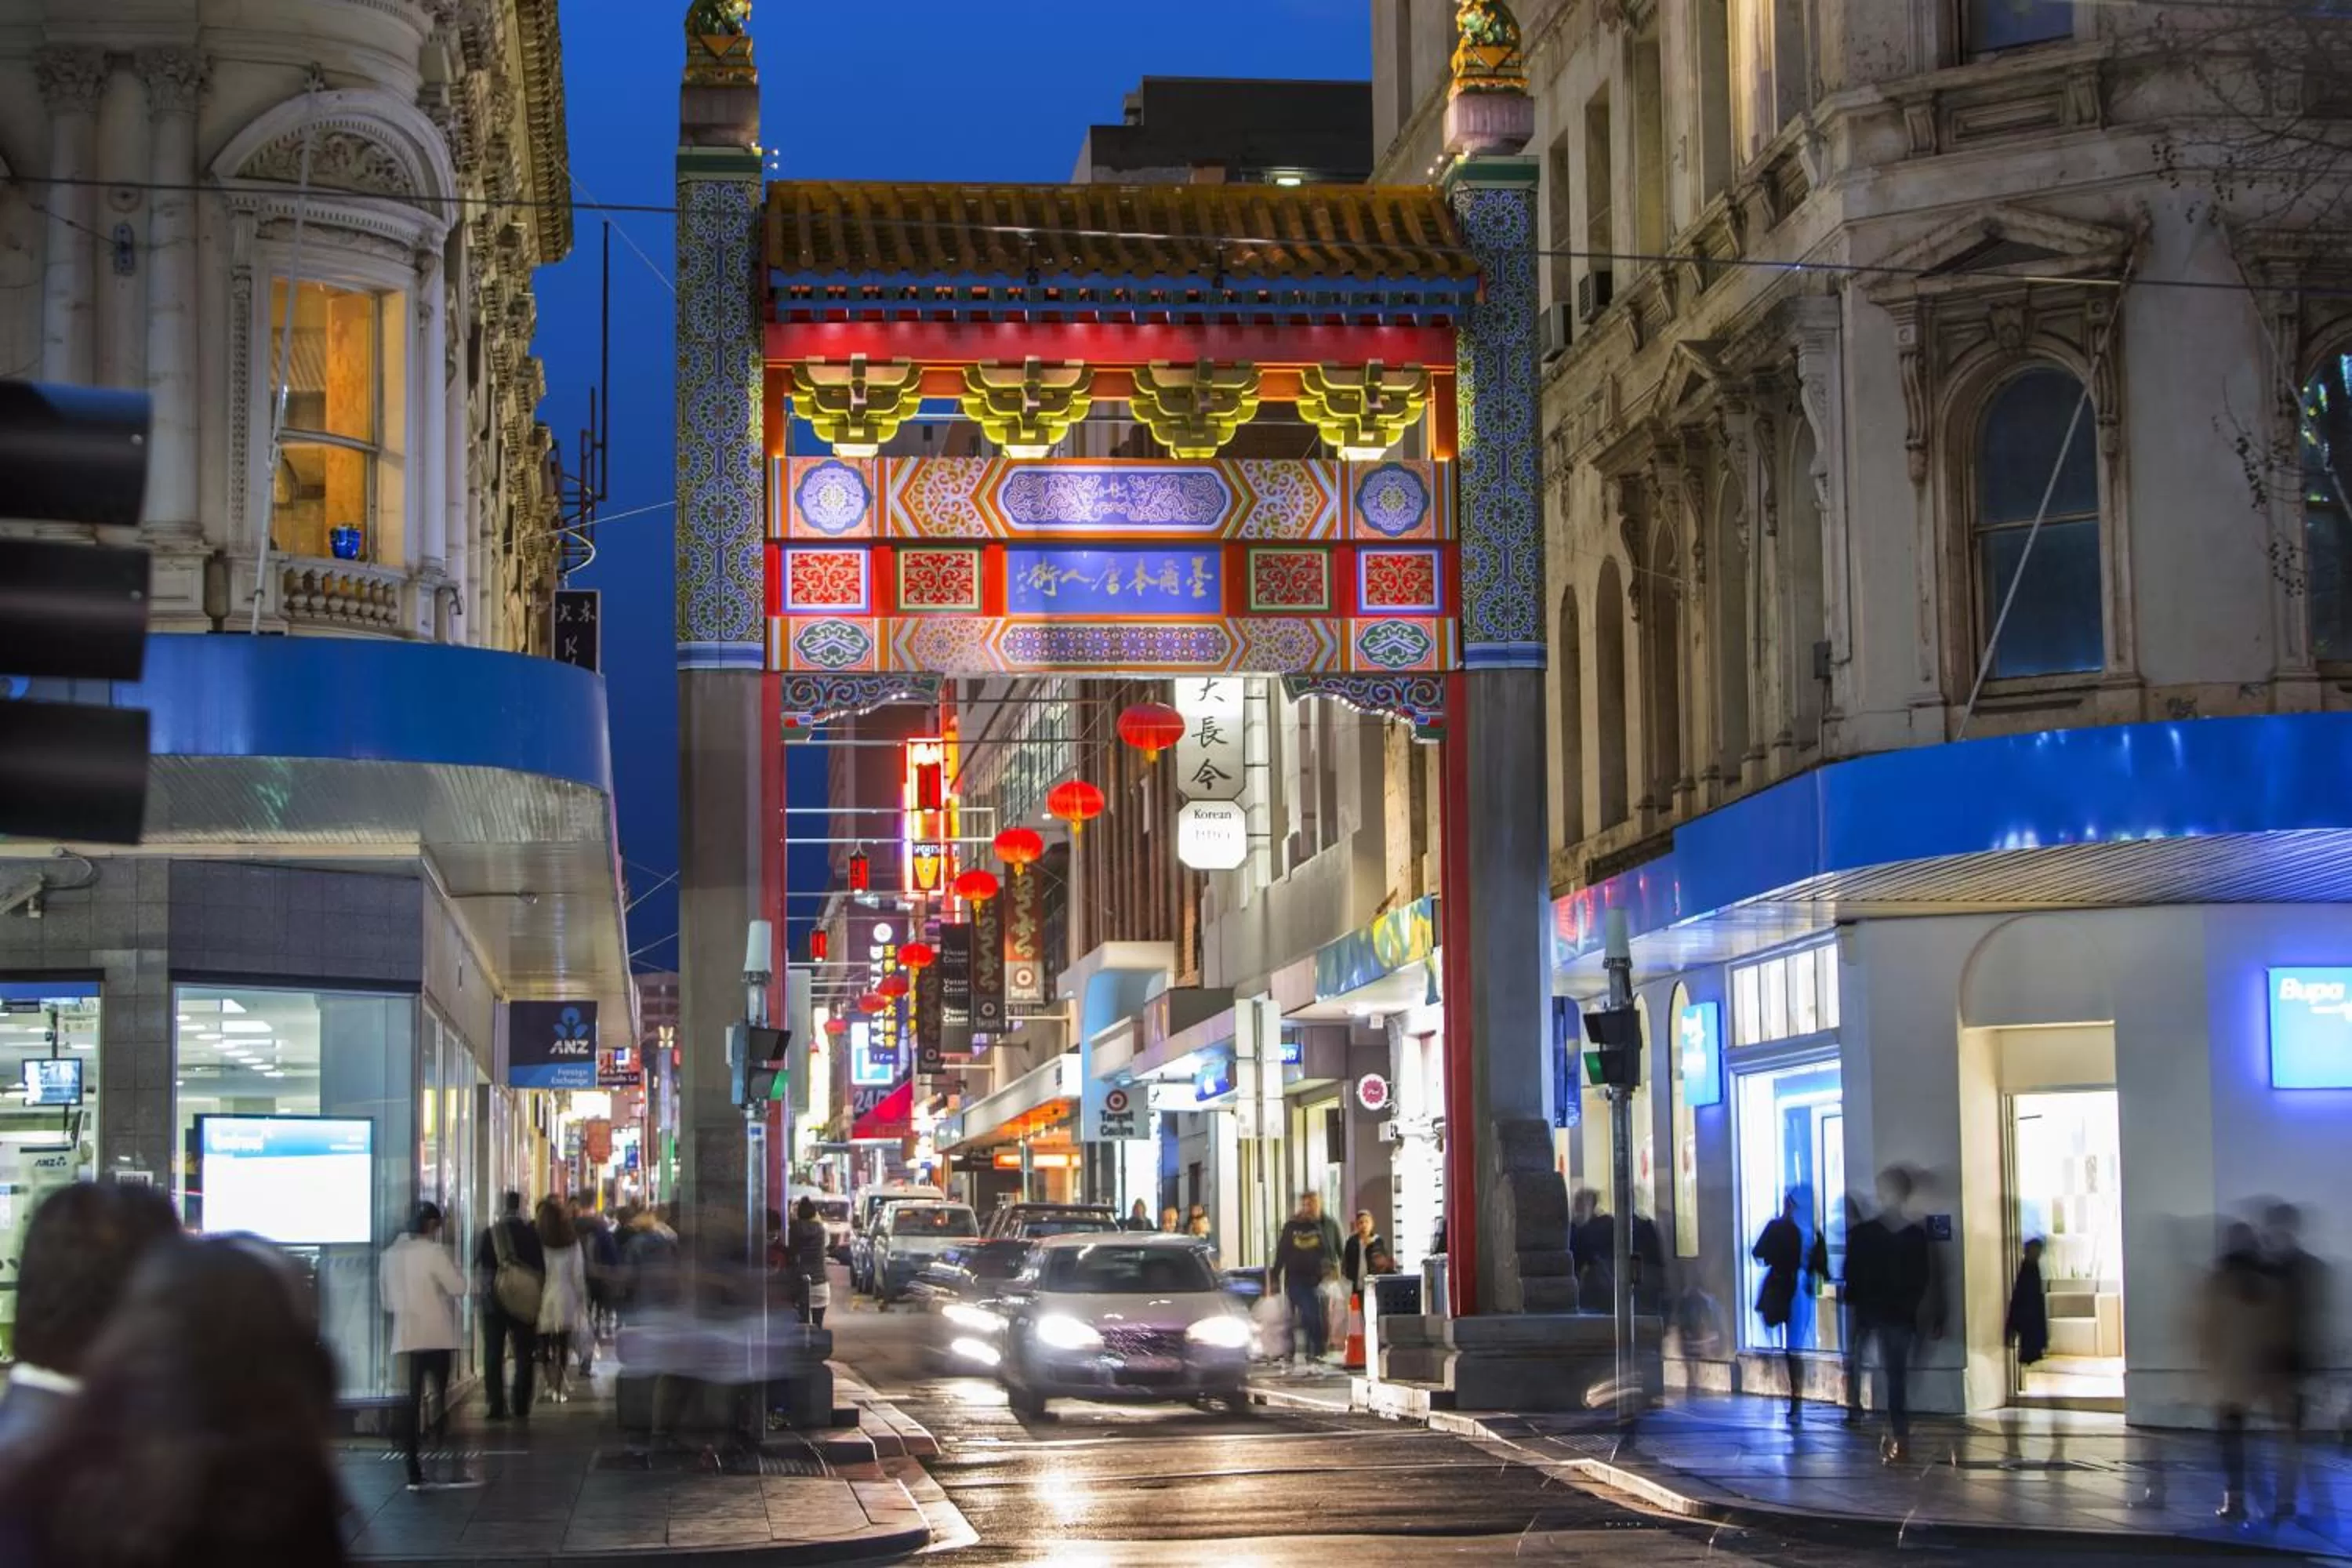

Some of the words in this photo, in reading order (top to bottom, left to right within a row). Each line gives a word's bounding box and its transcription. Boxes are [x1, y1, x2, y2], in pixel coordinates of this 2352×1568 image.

[1192, 678, 1232, 790] 大長今
[1194, 808, 1232, 820] Korean
[869, 945, 884, 1047] DYNTY
[2279, 978, 2345, 1004] Bupa
[550, 1040, 590, 1054] ANZ
[557, 1068, 588, 1077] Foreign
[551, 1076, 588, 1086] Exchange
[1100, 1109, 1134, 1124] Target
